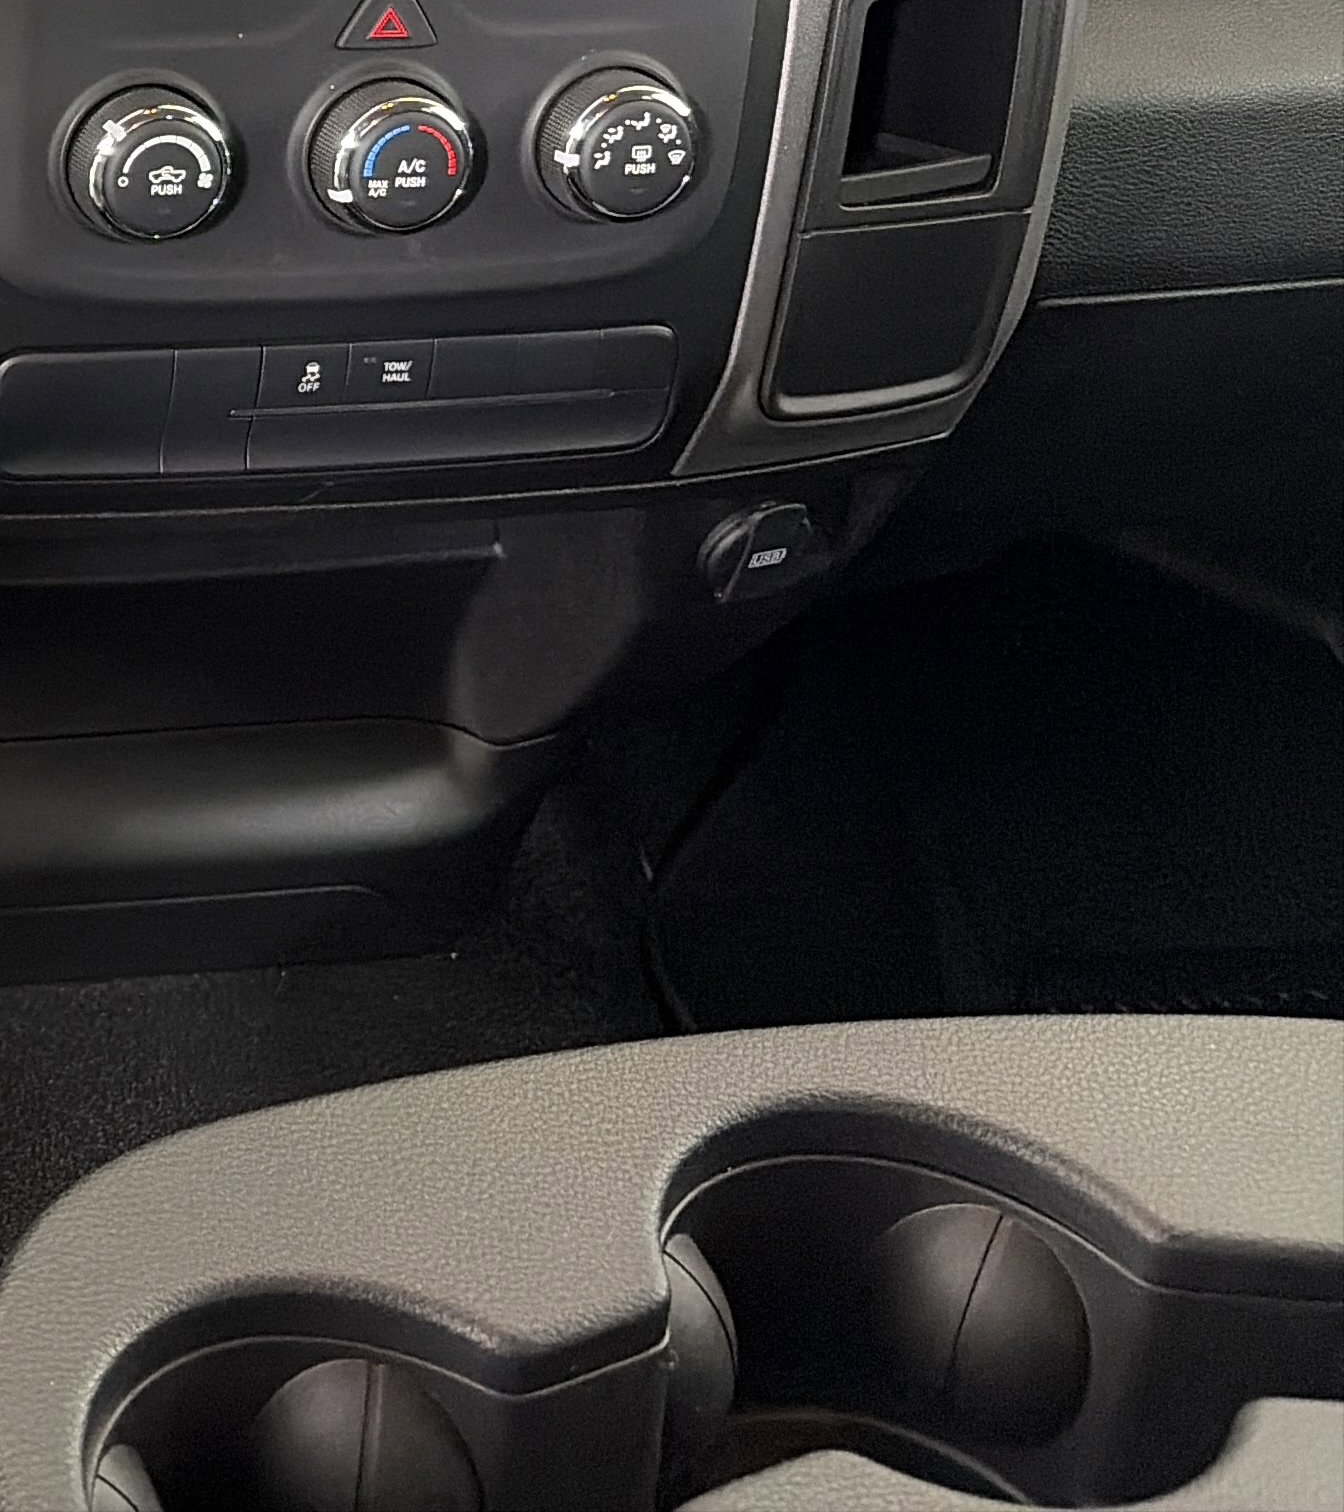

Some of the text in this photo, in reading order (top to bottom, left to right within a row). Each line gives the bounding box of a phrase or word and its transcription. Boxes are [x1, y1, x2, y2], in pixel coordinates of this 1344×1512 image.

[397, 158, 427, 174] A/C
[624, 162, 656, 175] PUSH
[368, 179, 389, 188] MAX
[394, 176, 426, 188] PUSH
[150, 184, 183, 196] PUSH
[368, 188, 387, 198] A/C
[383, 360, 413, 372] TOW/
[382, 372, 411, 383] HAUL
[297, 381, 321, 393] OFF
